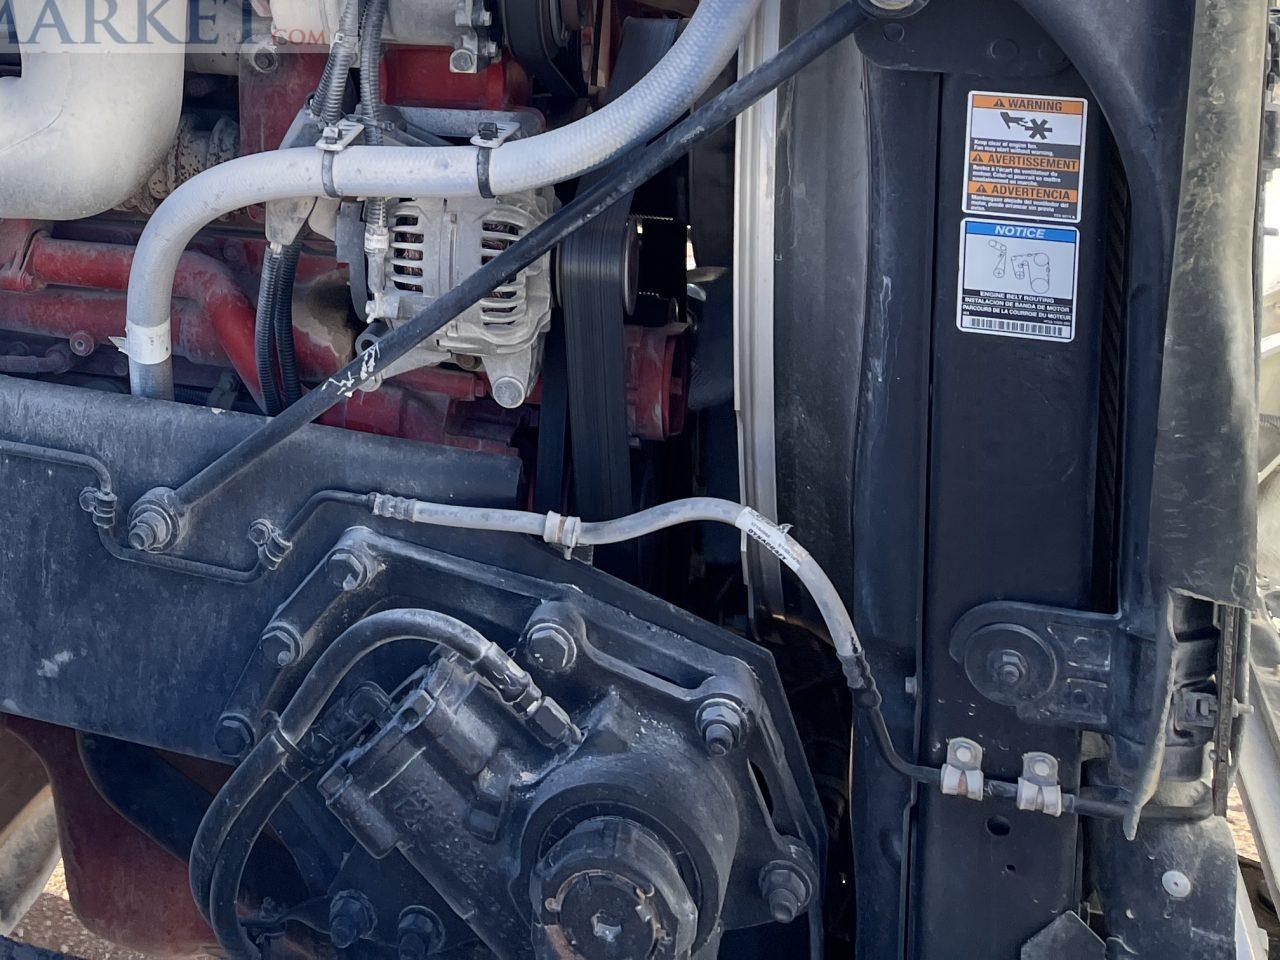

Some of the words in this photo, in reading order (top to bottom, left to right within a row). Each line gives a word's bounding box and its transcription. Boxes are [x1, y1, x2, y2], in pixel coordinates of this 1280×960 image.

[1008, 98, 1063, 112] WARNING
[988, 153, 1078, 170] AVERTISSEMENT
[992, 184, 1070, 200] ADVERTENCIA
[994, 225, 1047, 238] NOTICE
[1024, 296, 1054, 304] ROUTING
